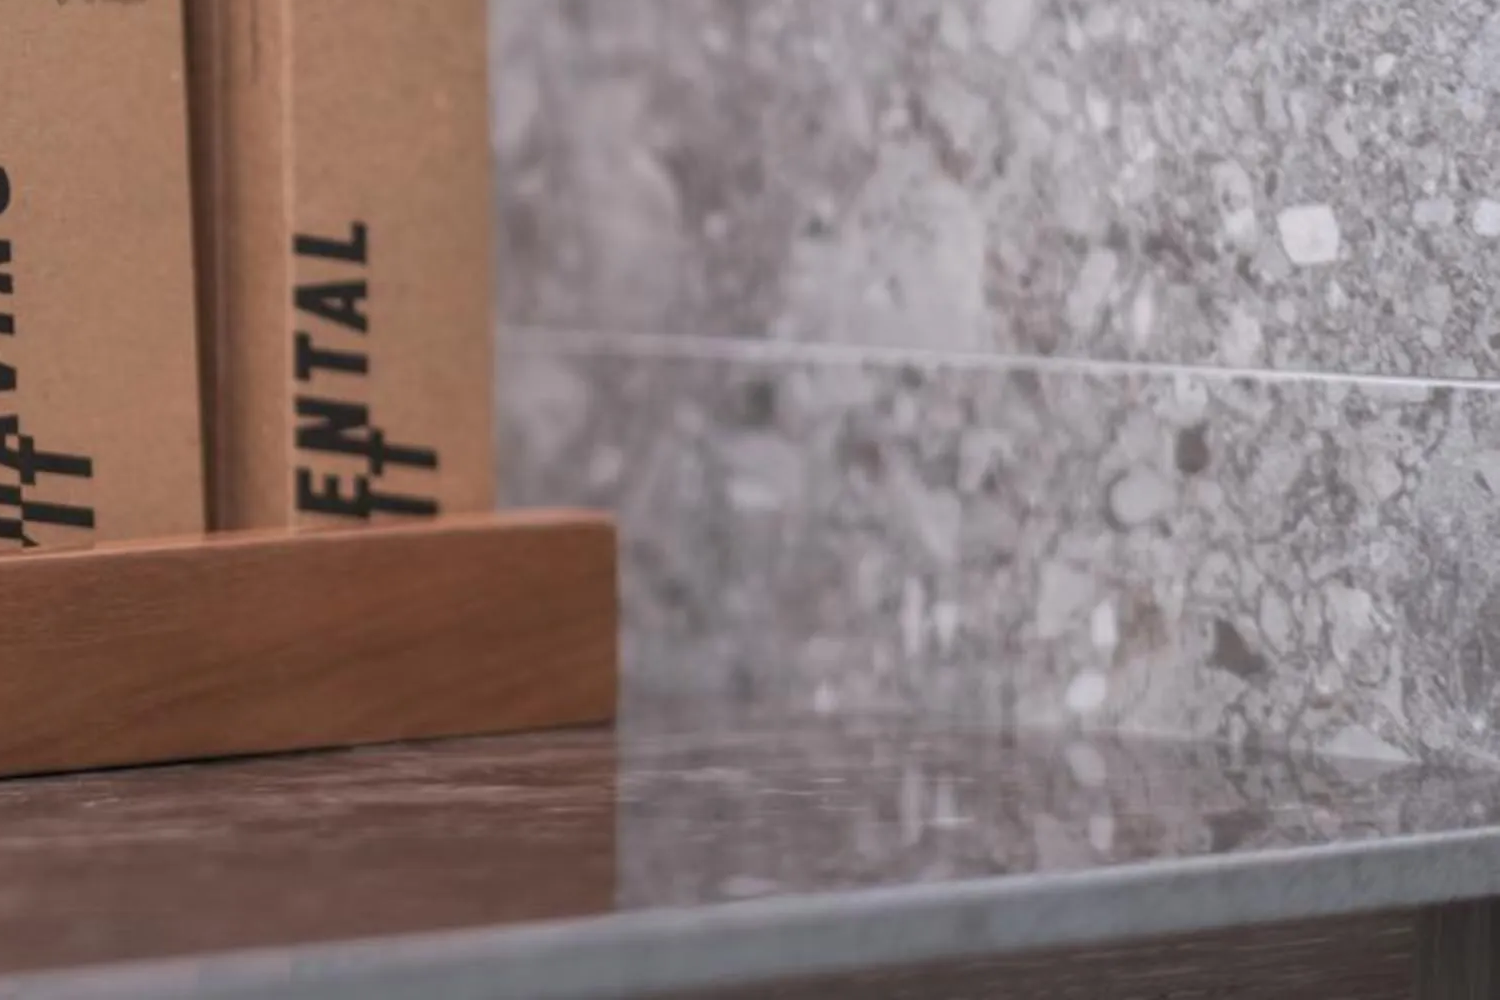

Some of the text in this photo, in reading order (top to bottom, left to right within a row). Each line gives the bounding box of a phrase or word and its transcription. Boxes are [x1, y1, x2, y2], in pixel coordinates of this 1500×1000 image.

[292, 220, 370, 520] ENTAL
[17, 434, 95, 548] IT
[366, 427, 440, 518] IT
